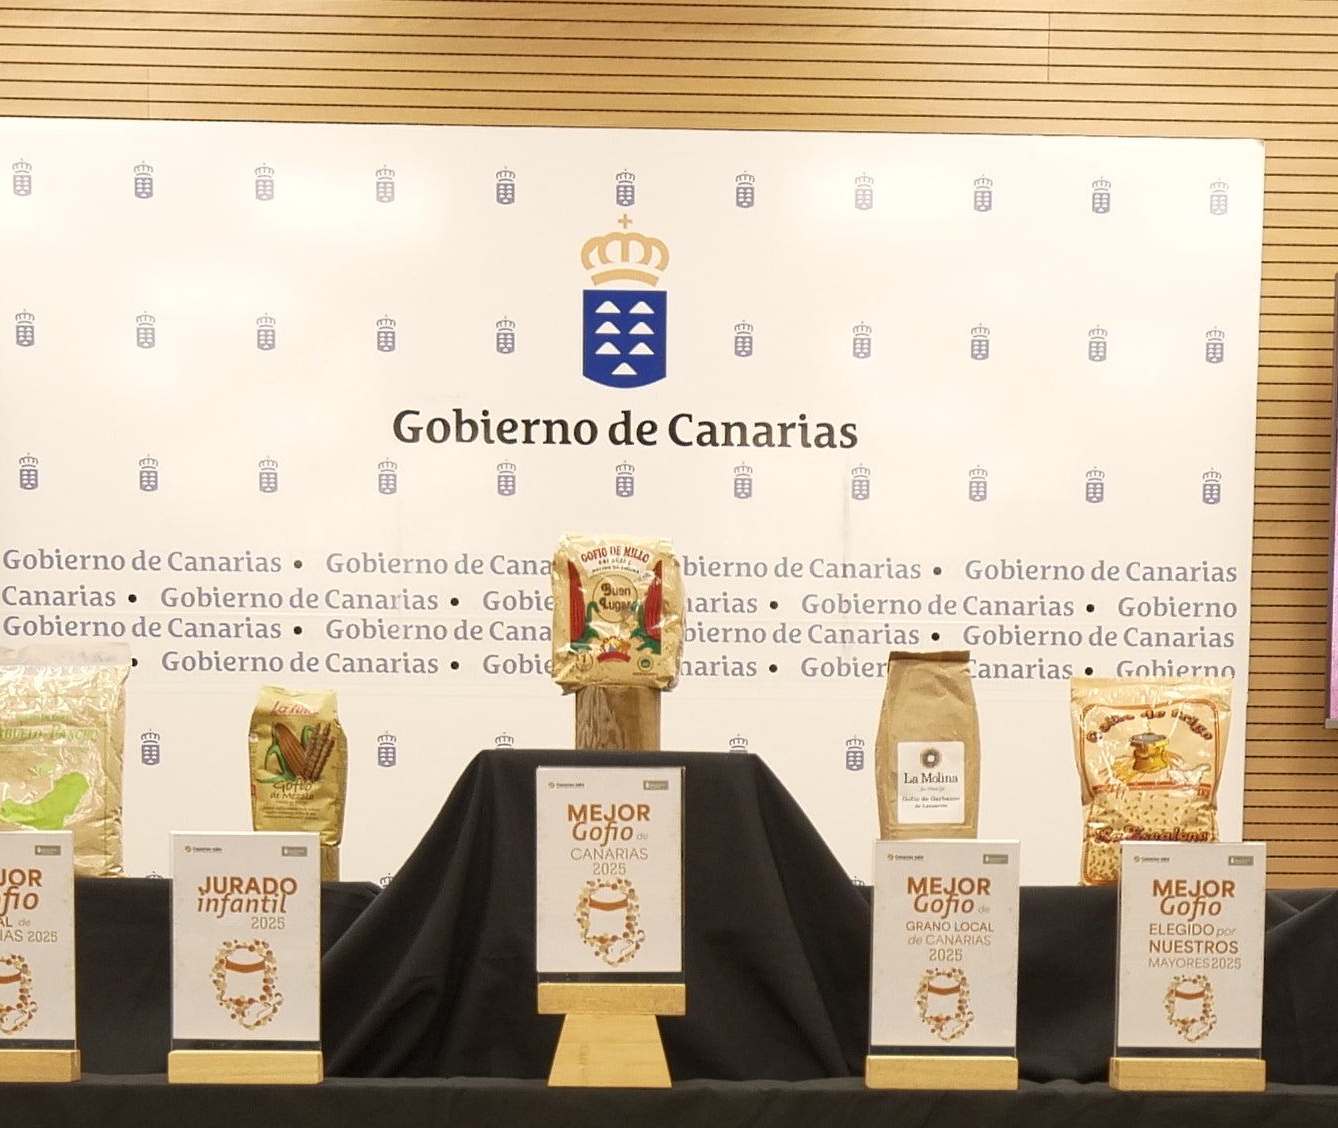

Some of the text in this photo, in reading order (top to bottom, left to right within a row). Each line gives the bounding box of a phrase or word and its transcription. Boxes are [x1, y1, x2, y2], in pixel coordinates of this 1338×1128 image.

[392, 407, 859, 450] Gobierno de Canarias
[581, 546, 650, 563] GOFIO DE MILLO
[2, 548, 1238, 583] Gobierno de Canarias Gobierno de de Canarias Gobierno de Canarias
[601, 582, 632, 596] Buen
[2, 584, 1238, 618] Canarias Gobierno de Canarias Gobierno de Canarias Gobierno
[904, 771, 959, 784] La Molina
[567, 803, 651, 822] MEJOR
[571, 820, 634, 848] Gofio
[570, 847, 649, 861] CANARIAS
[593, 862, 627, 876] 2025
[197, 876, 298, 896] JURADO
[907, 877, 991, 896] MEJOR
[1152, 879, 1236, 898] MEJOR
[197, 893, 287, 919] infantil
[913, 893, 975, 920] Gofio
[1160, 895, 1222, 922] Gofio
[251, 916, 286, 930] 2025
[905, 920, 995, 933] GRANO LOCAL
[1149, 923, 1238, 939] ELEGIDO por
[27, 930, 59, 943] 2025
[907, 935, 992, 947] de CANARIAS
[1149, 939, 1239, 954] NUESTROS
[928, 948, 963, 962] 2025
[1148, 957, 1242, 971] MAYORES 2025
